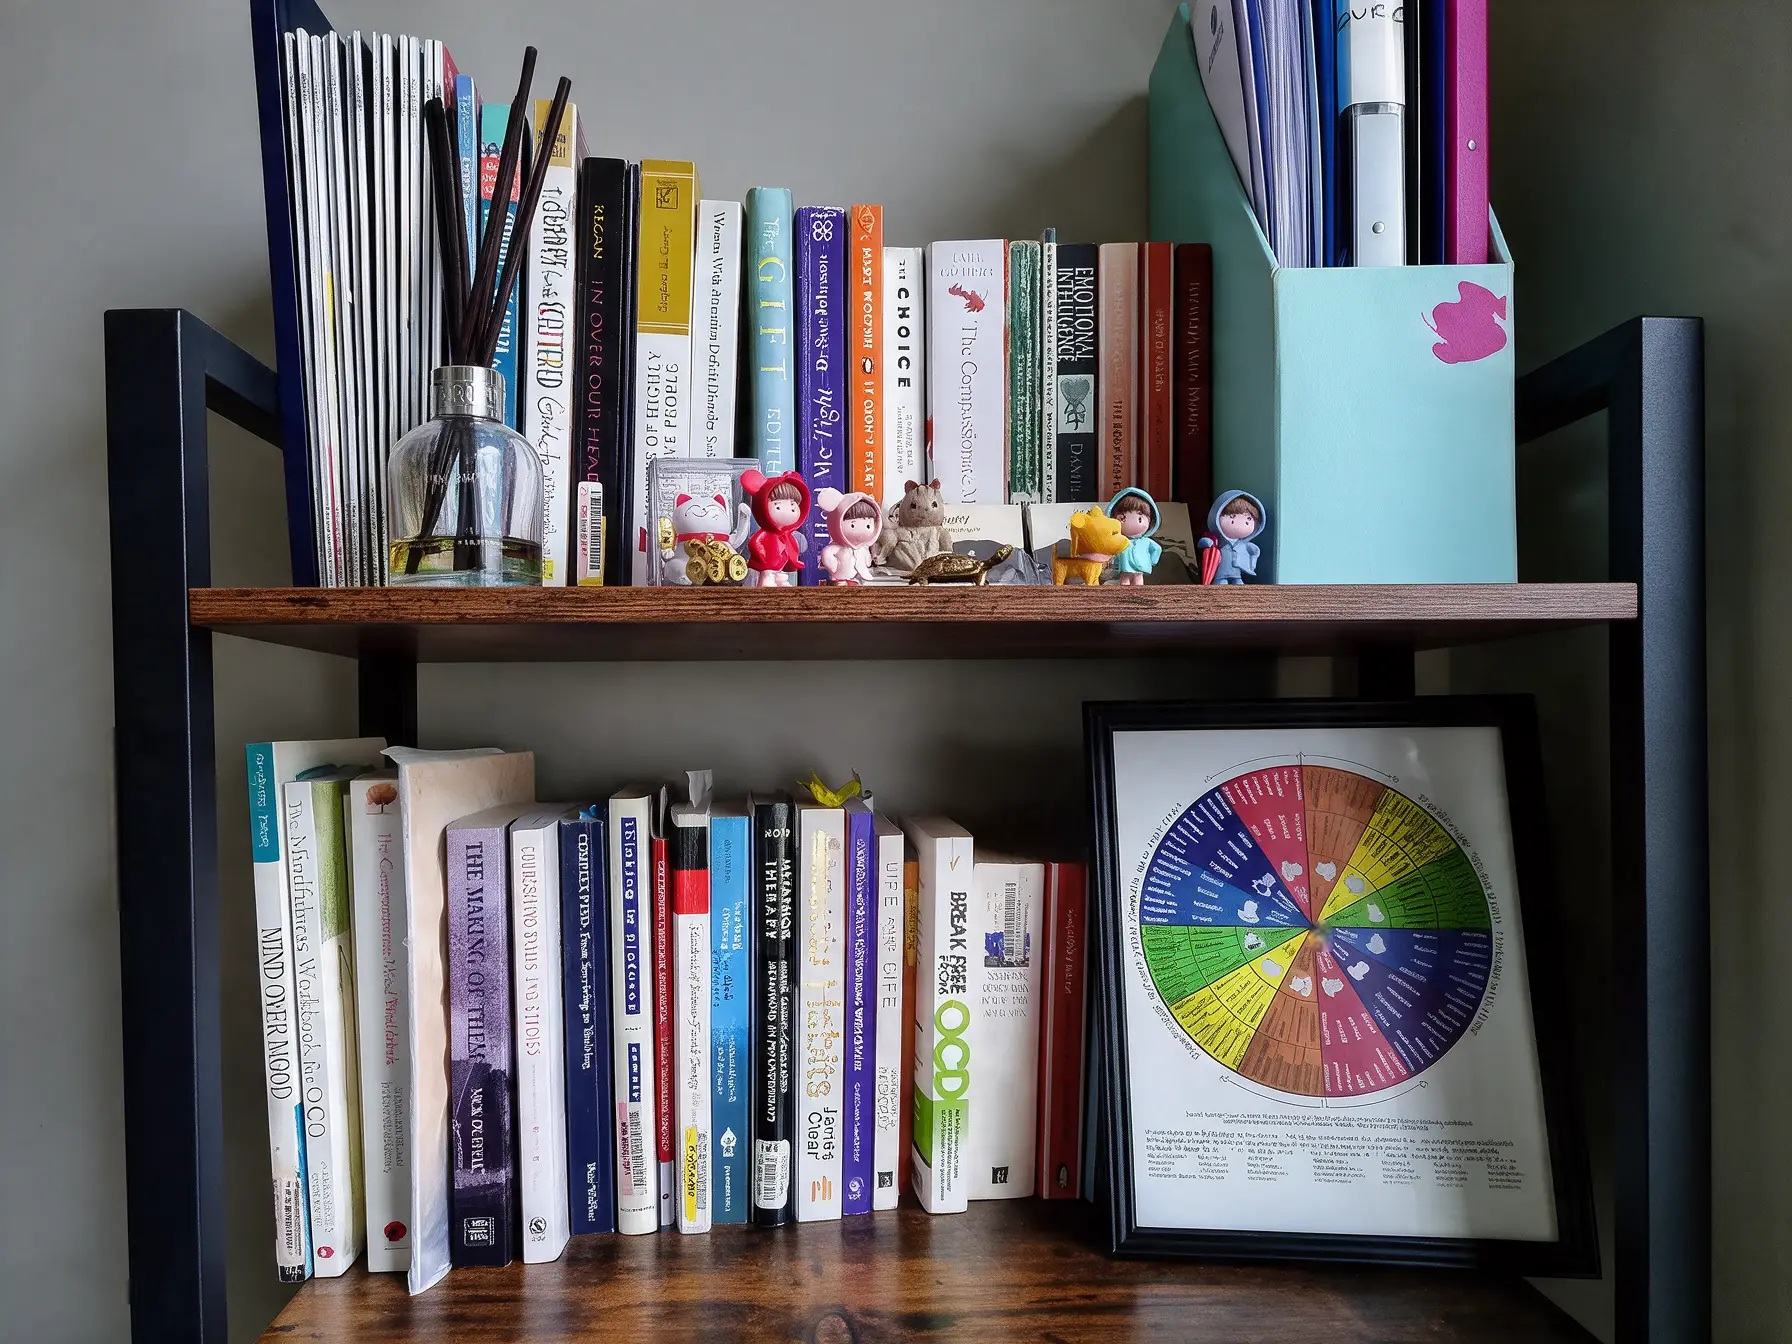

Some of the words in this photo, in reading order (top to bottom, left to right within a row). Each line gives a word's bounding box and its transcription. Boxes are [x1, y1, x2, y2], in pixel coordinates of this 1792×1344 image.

[590, 280, 604, 304] IN
[758, 255, 787, 381] GIFT
[1074, 266, 1094, 362] EMOTIONAL
[589, 312, 603, 367] OVER
[897, 287, 911, 388] CHOICE
[960, 322, 979, 356] The
[587, 373, 602, 418] OUR
[812, 388, 840, 441] Tight
[645, 423, 659, 448] OF
[465, 841, 485, 880] THE
[465, 887, 486, 964] MAKING
[949, 891, 967, 951] BREAK
[261, 927, 285, 980] MIND
[264, 984, 287, 1036] OVER
[466, 971, 486, 998] OF
[267, 1040, 293, 1100] MOOD
[934, 999, 971, 1100] OCD
[806, 1111, 823, 1161] Clear
[822, 1106, 838, 1161] James
